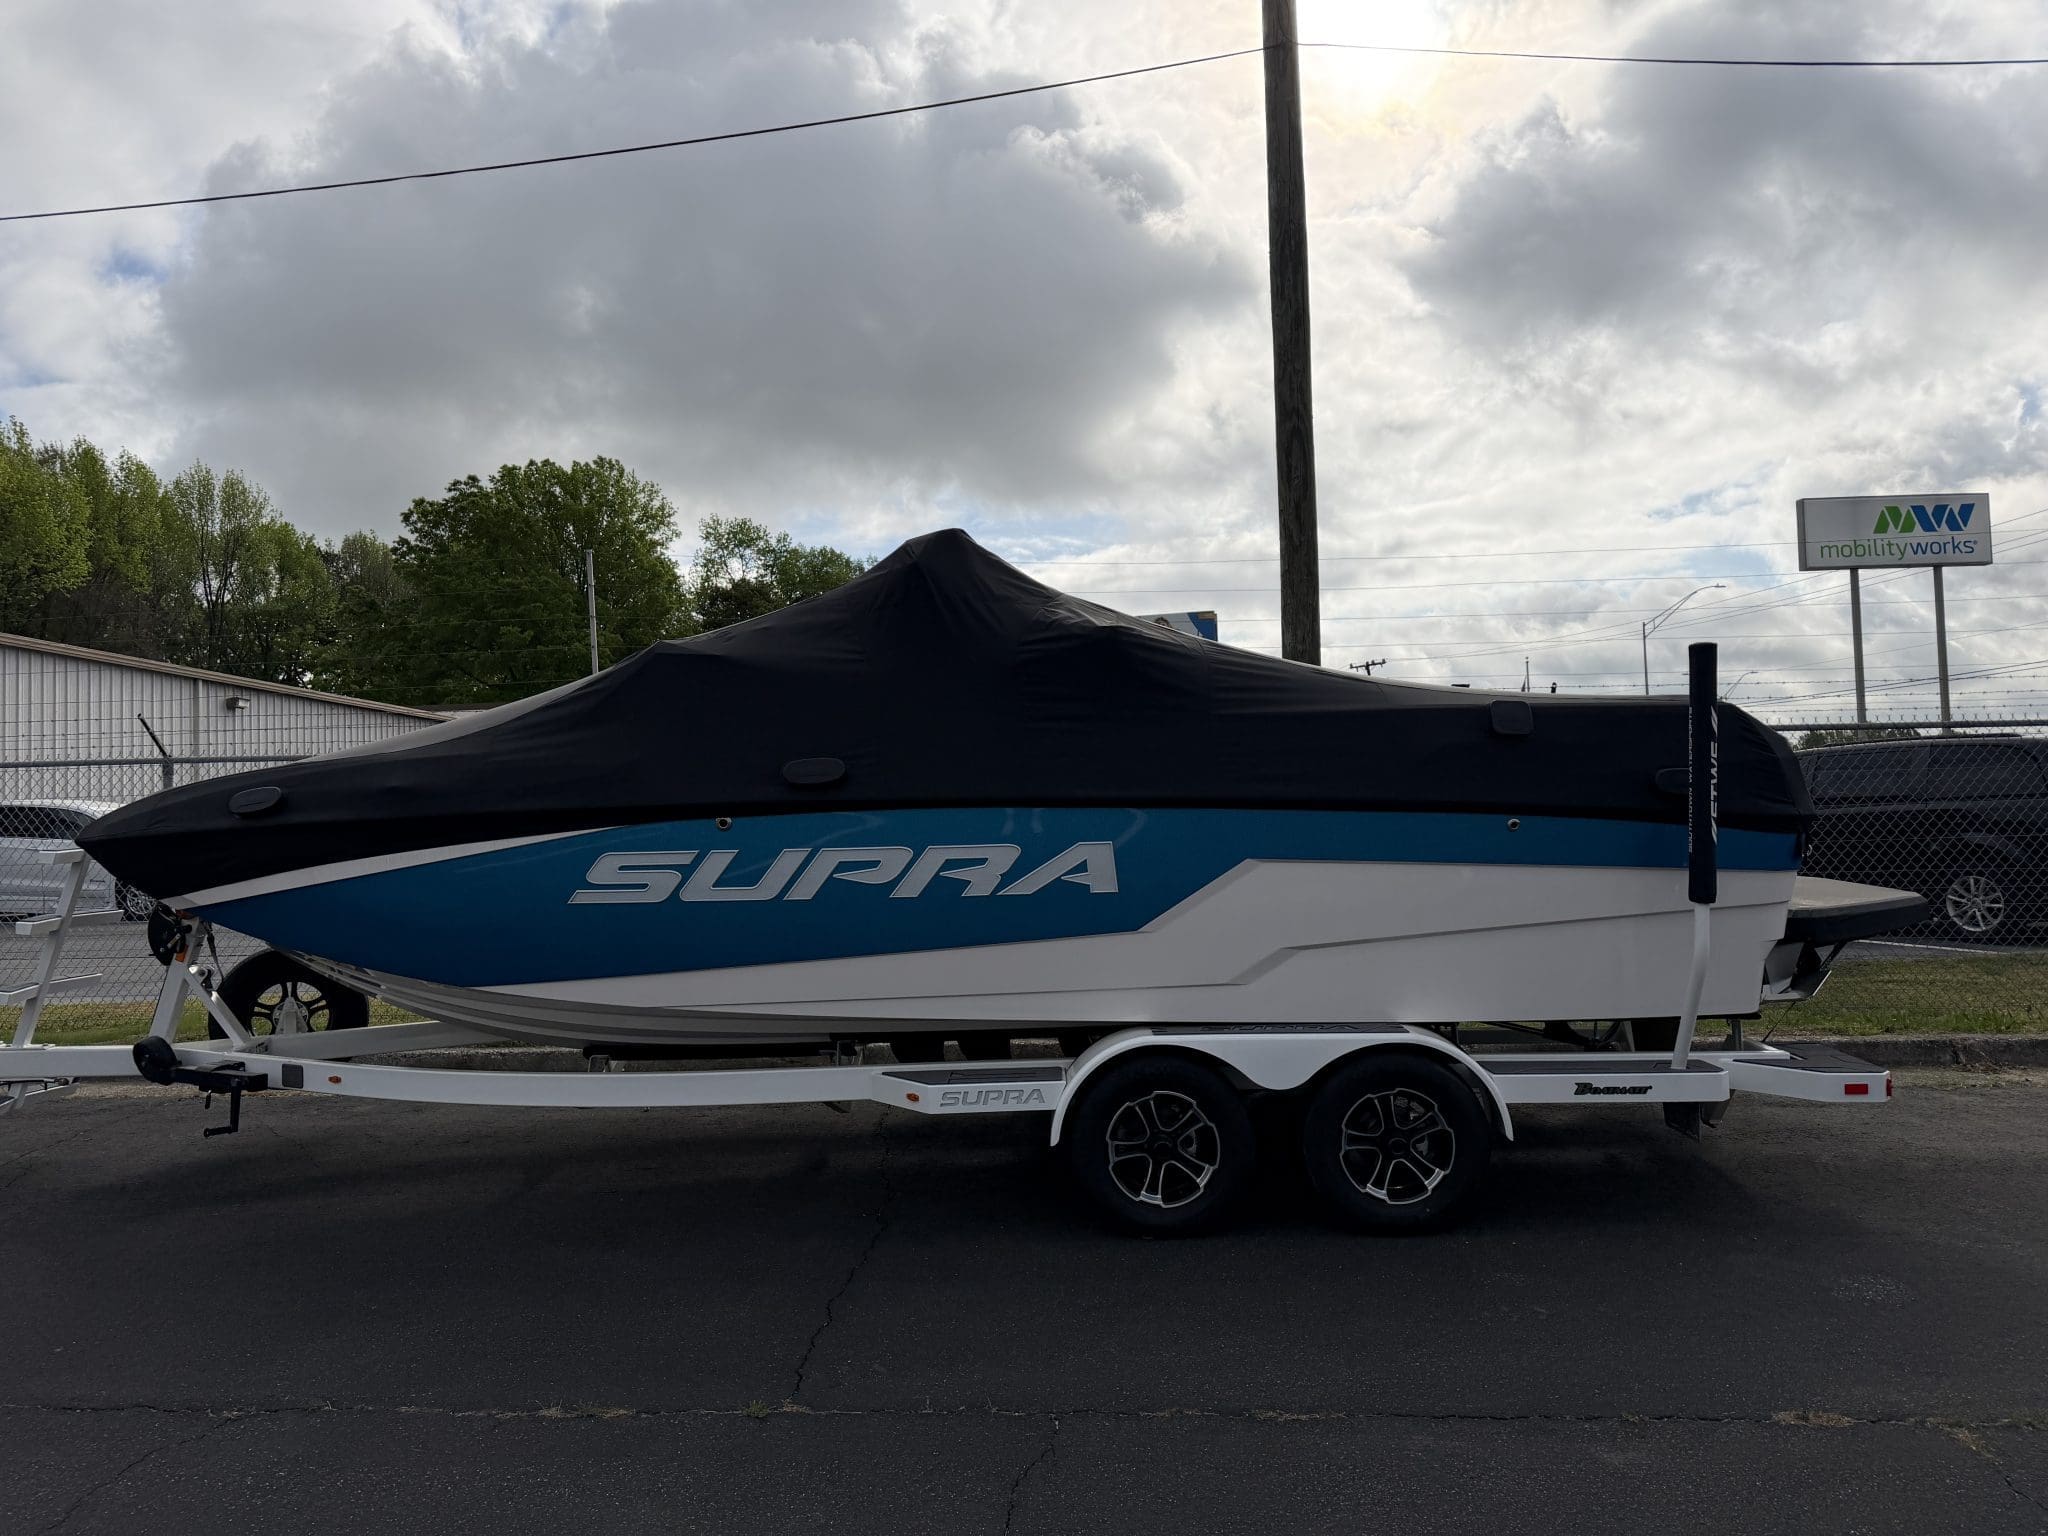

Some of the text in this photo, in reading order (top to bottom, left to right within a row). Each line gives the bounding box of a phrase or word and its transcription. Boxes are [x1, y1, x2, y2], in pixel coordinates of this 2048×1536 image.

[1820, 536, 1976, 561] mobilityworks
[567, 841, 1119, 904] SUPRA
[940, 1088, 1046, 1107] SUPRA
